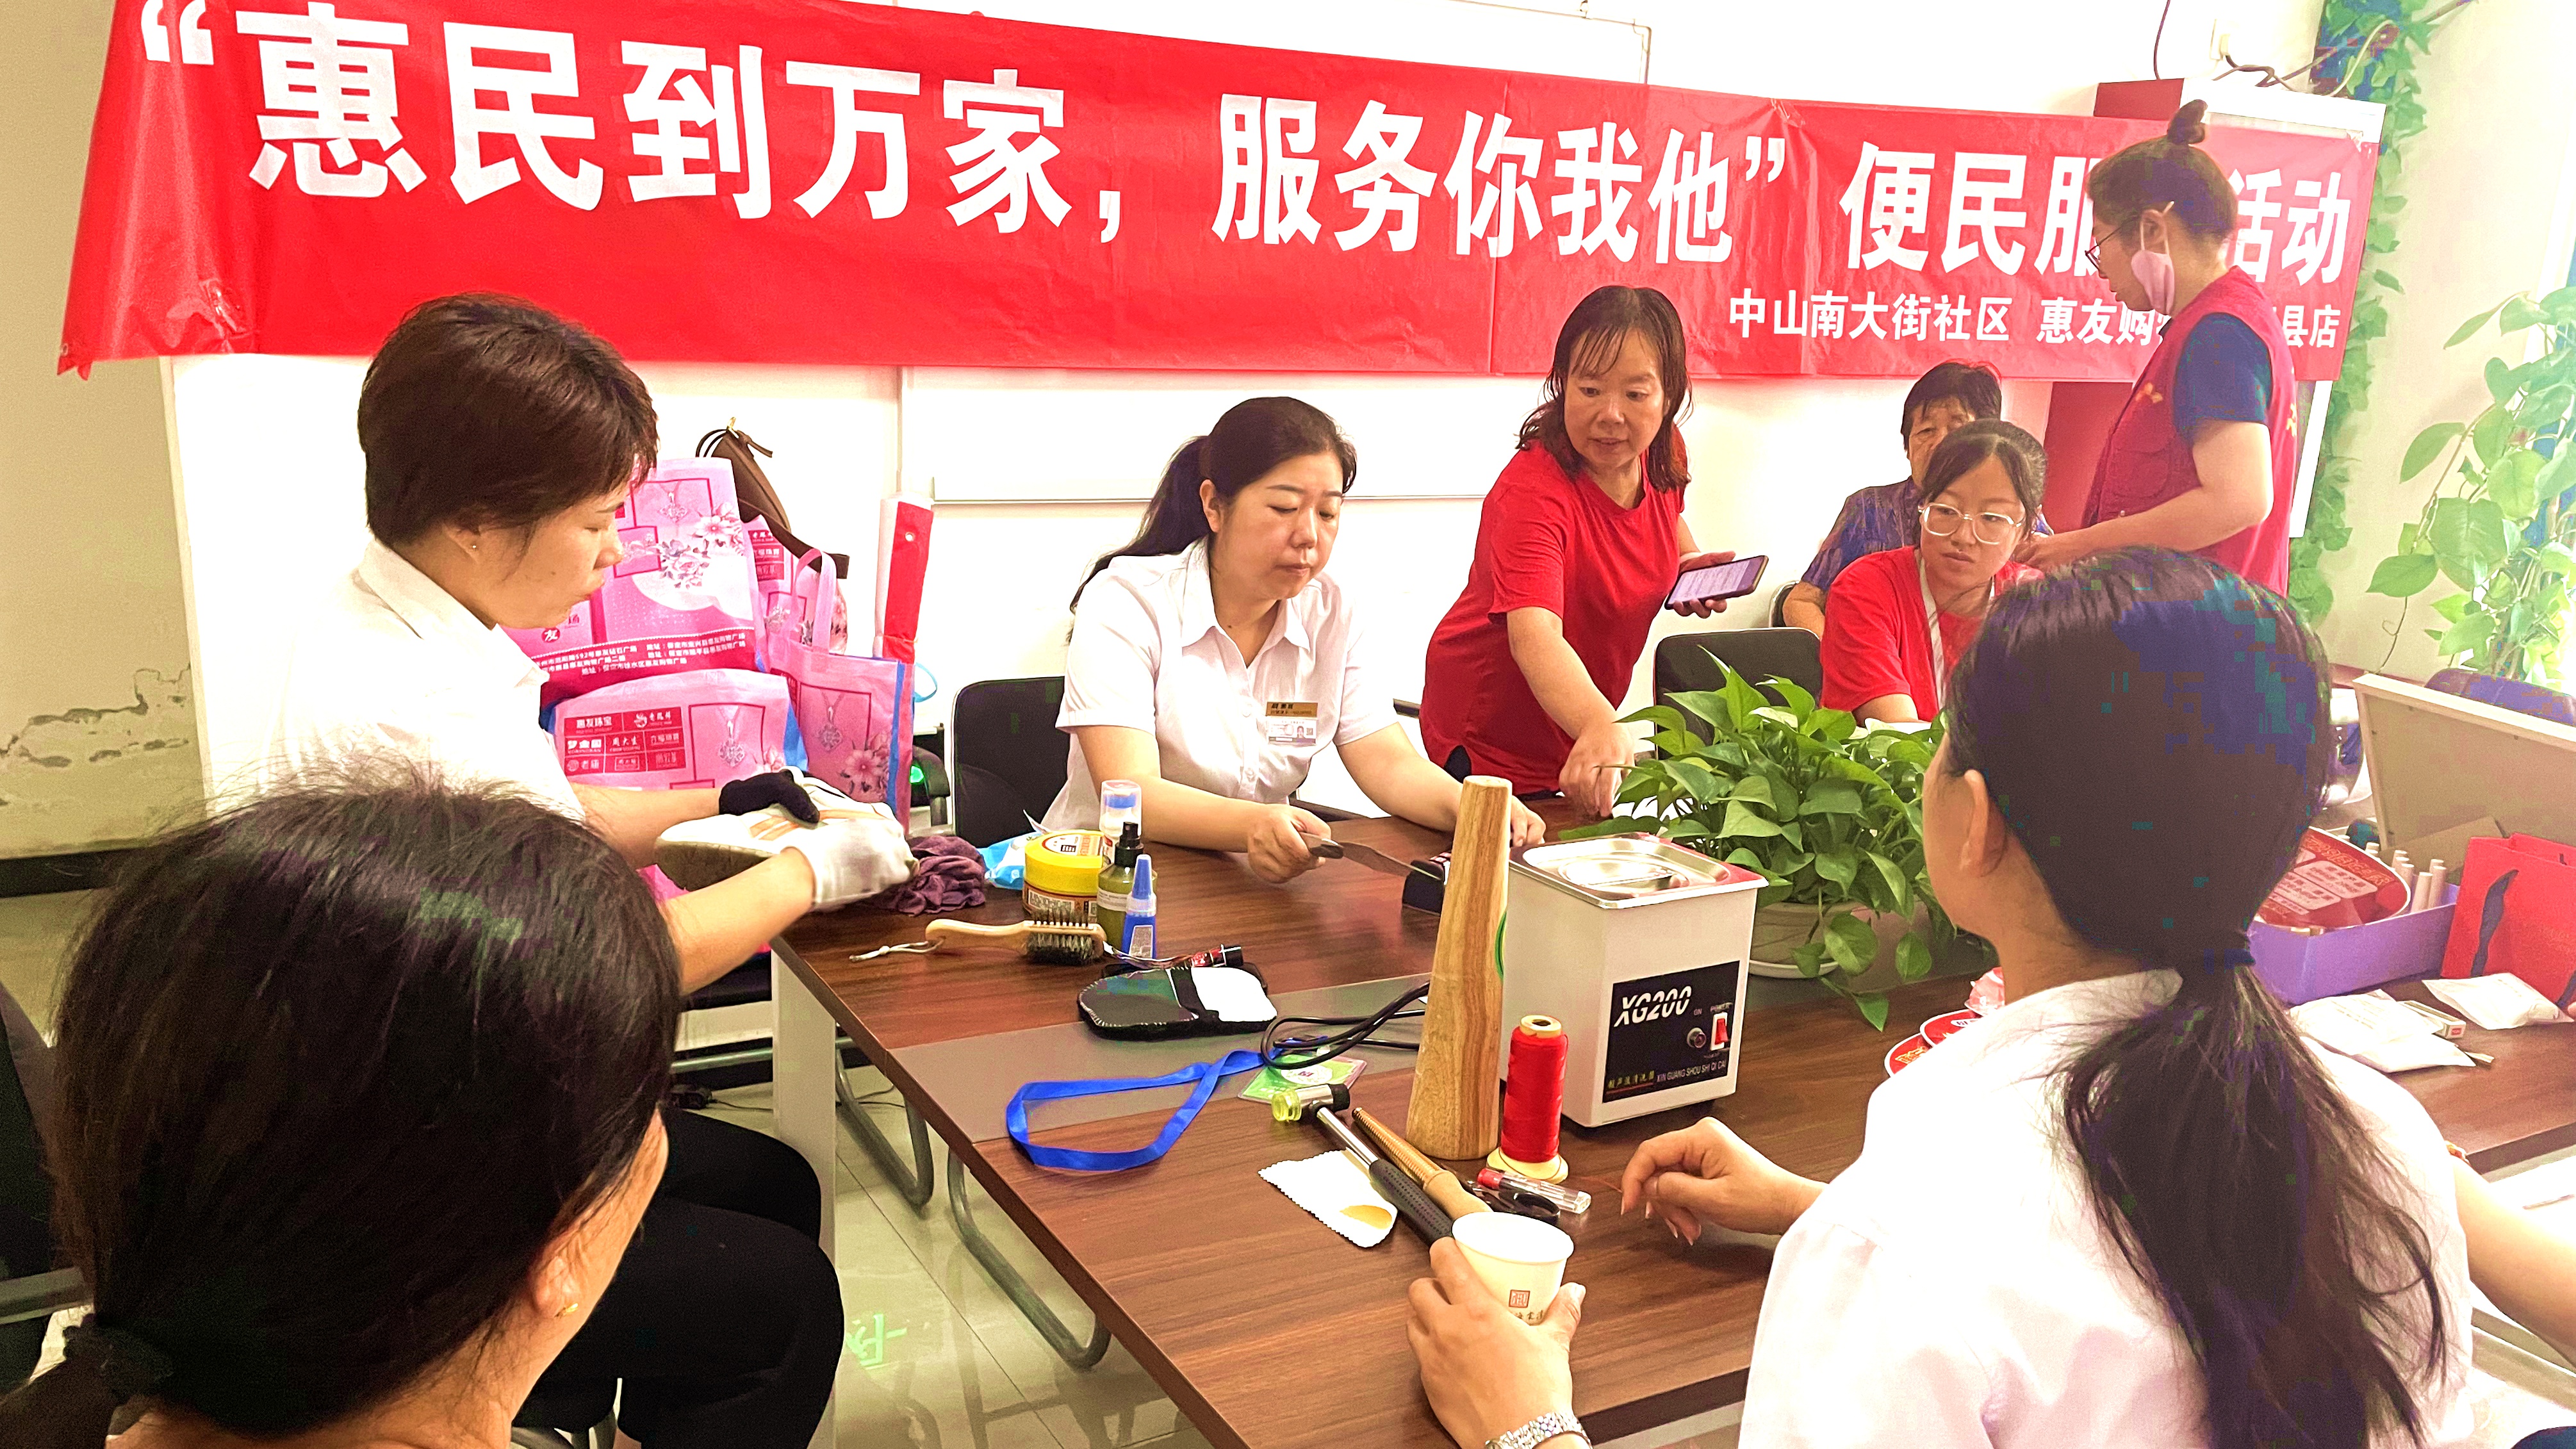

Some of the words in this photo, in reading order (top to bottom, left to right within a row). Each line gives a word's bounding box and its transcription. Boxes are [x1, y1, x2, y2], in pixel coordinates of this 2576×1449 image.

[1840, 141, 2350, 286] 便民服活动
[1730, 288, 2013, 342] 中山南大街社区
[1614, 985, 1693, 1027] XG200
[1667, 1068, 1686, 1080] GUANG
[1686, 1065, 1702, 1077] SHOU
